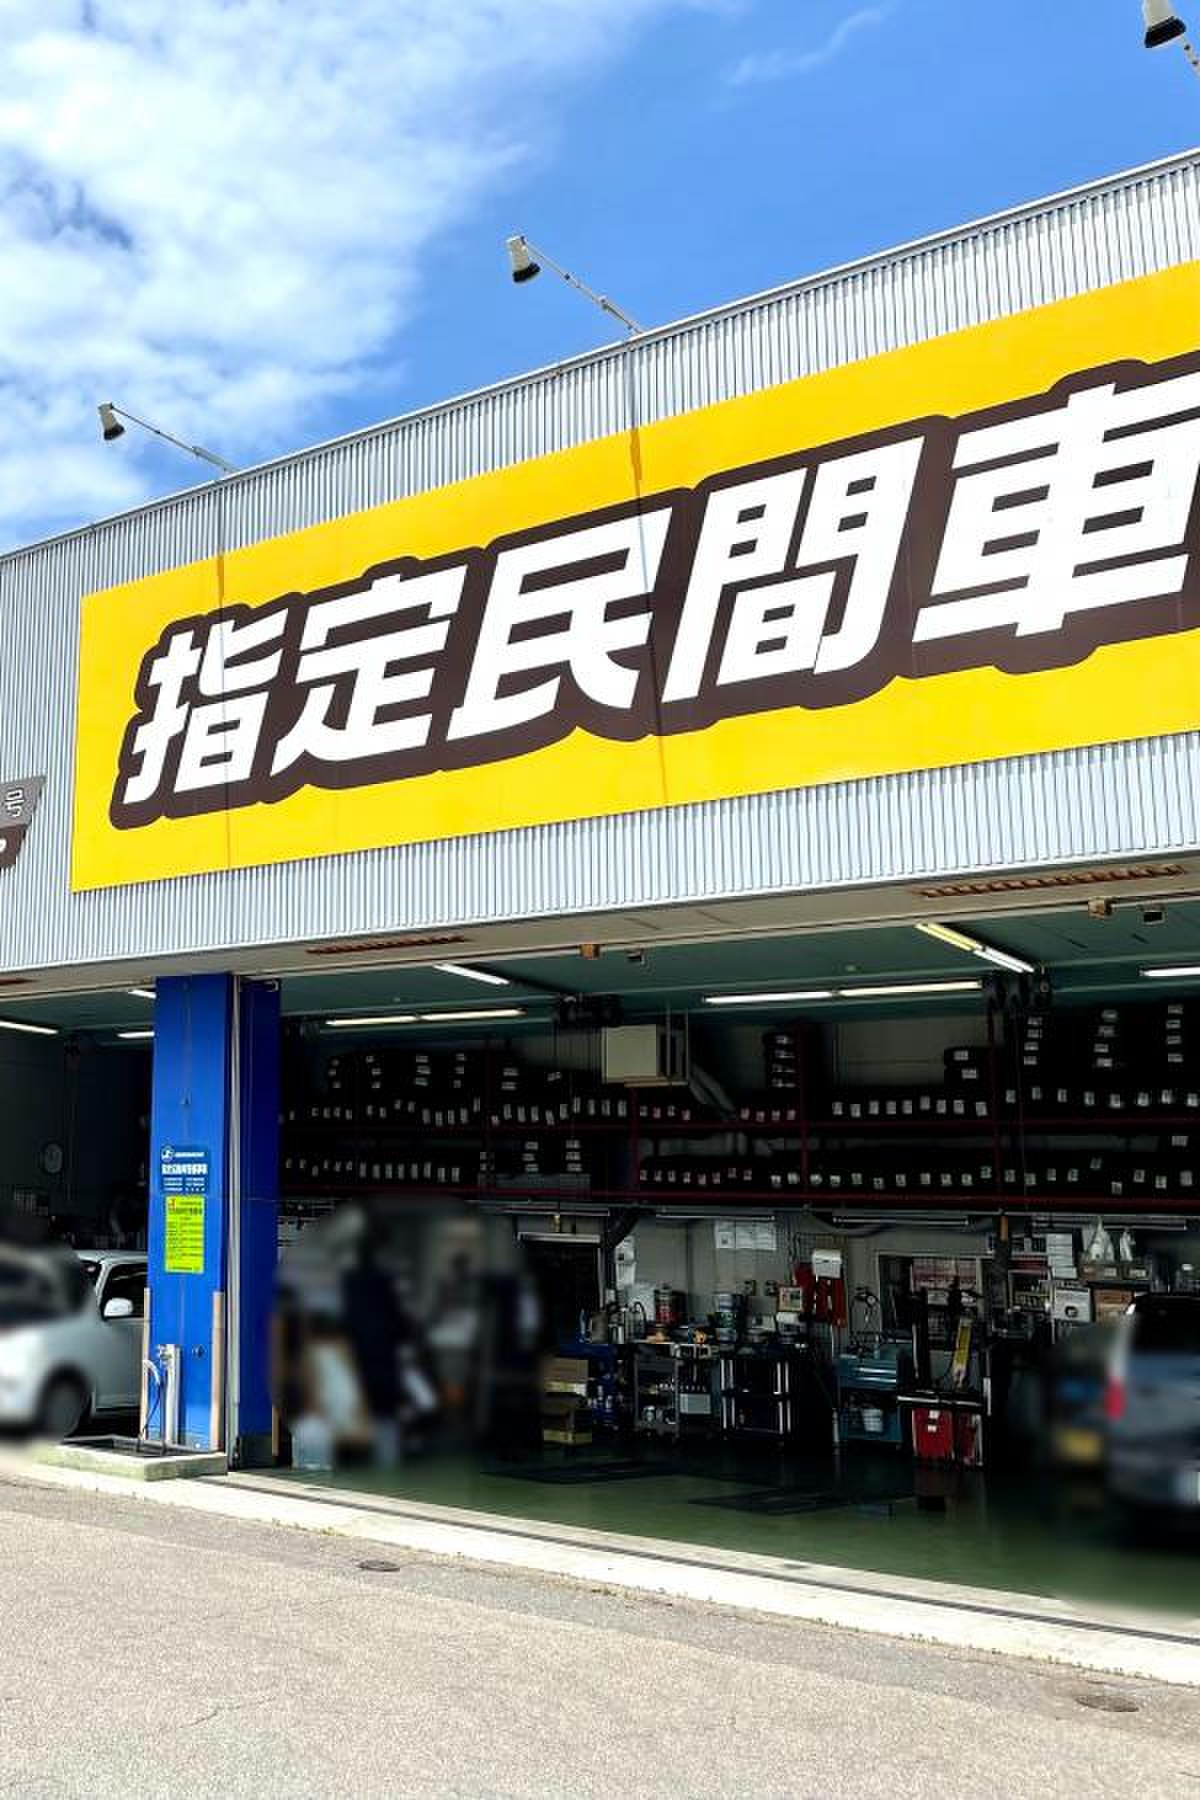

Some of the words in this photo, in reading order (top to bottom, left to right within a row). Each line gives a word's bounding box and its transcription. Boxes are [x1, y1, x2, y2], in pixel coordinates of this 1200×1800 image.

[123, 380, 1200, 803] 指定民間車
